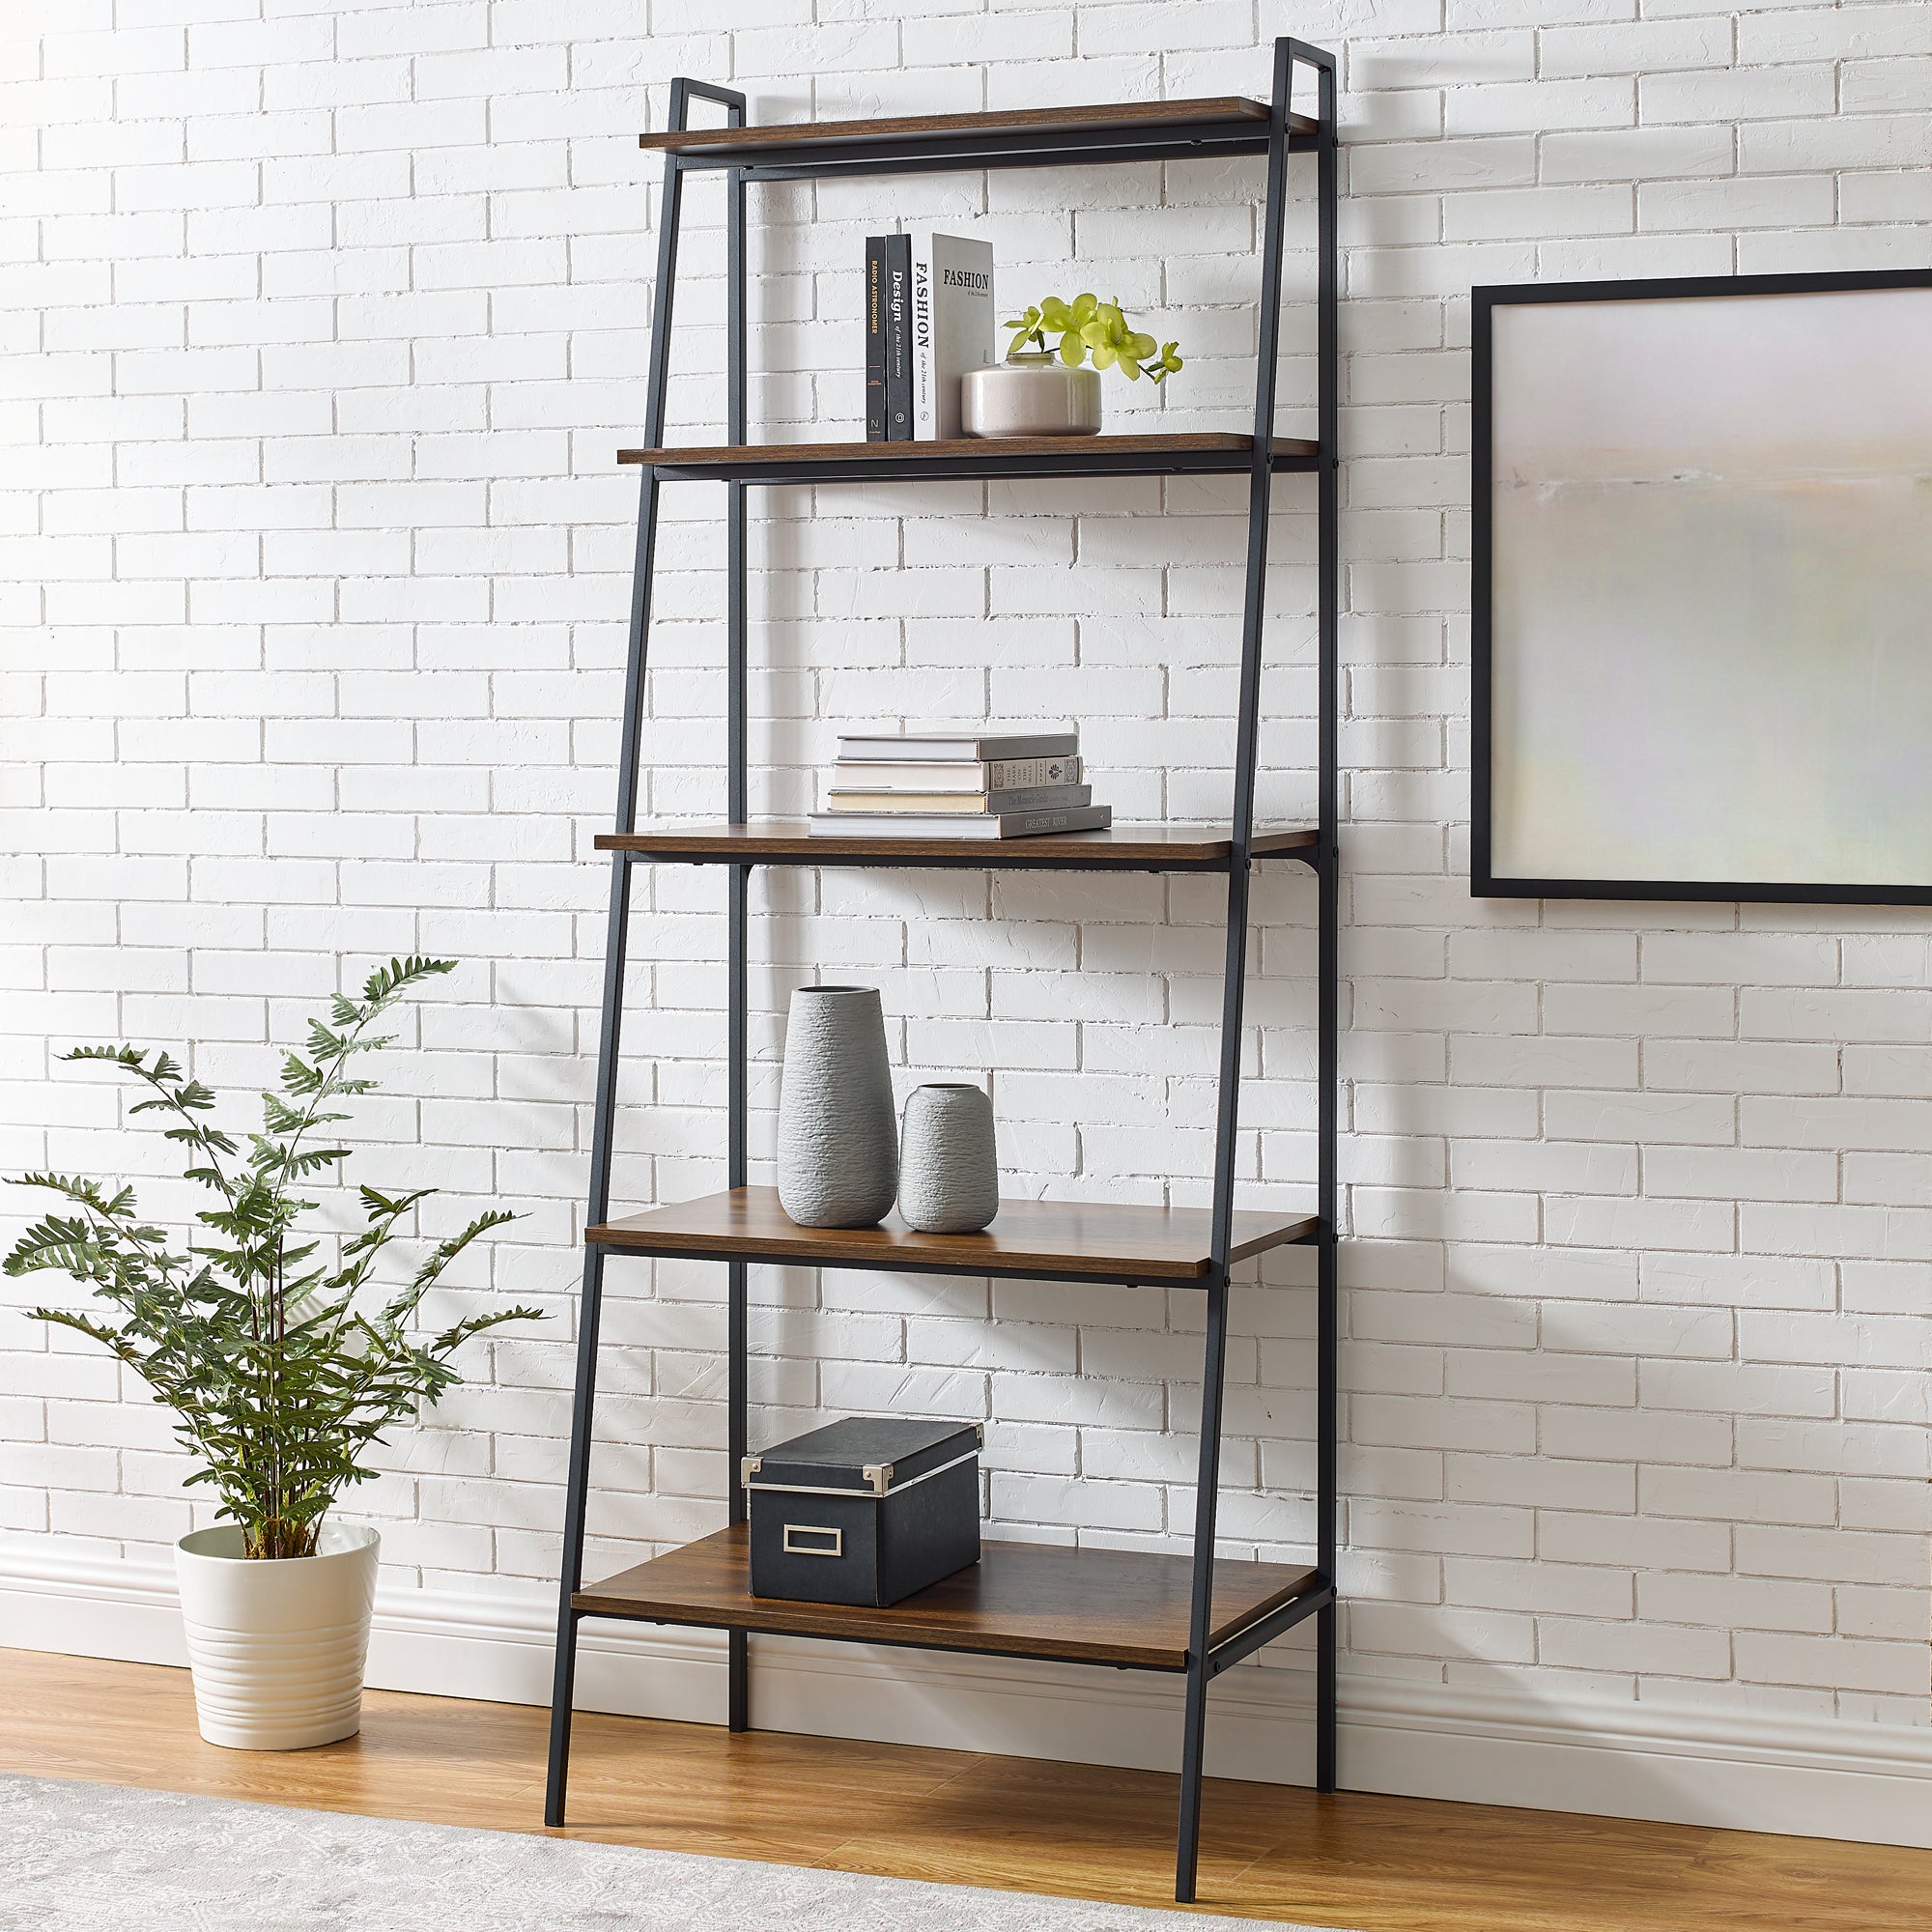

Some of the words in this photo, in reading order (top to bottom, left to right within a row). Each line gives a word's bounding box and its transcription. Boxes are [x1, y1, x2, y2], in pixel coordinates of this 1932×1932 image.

[891, 270, 904, 323] Design
[944, 269, 989, 290] FASHION
[917, 262, 929, 348] FASHION
[1025, 818, 1050, 830] GREATEST
[1052, 816, 1066, 826] RIVER
